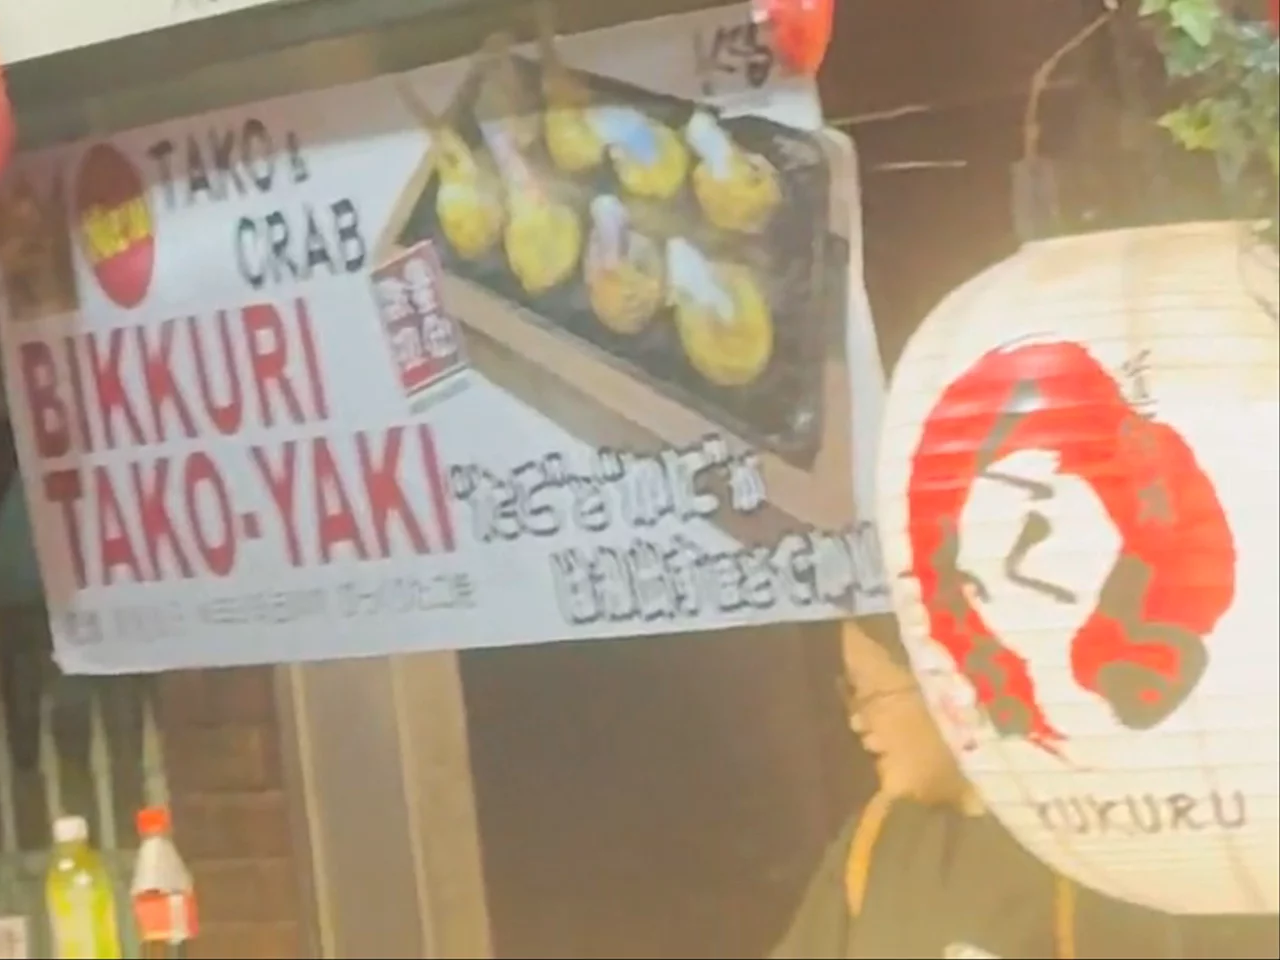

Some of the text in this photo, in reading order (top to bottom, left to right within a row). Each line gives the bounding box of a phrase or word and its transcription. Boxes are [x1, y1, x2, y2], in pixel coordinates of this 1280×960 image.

[148, 118, 275, 211] TAKO
[238, 198, 367, 290] CRAB
[20, 299, 329, 459] BIKKURI
[44, 423, 456, 588] TAKO-YAKI
